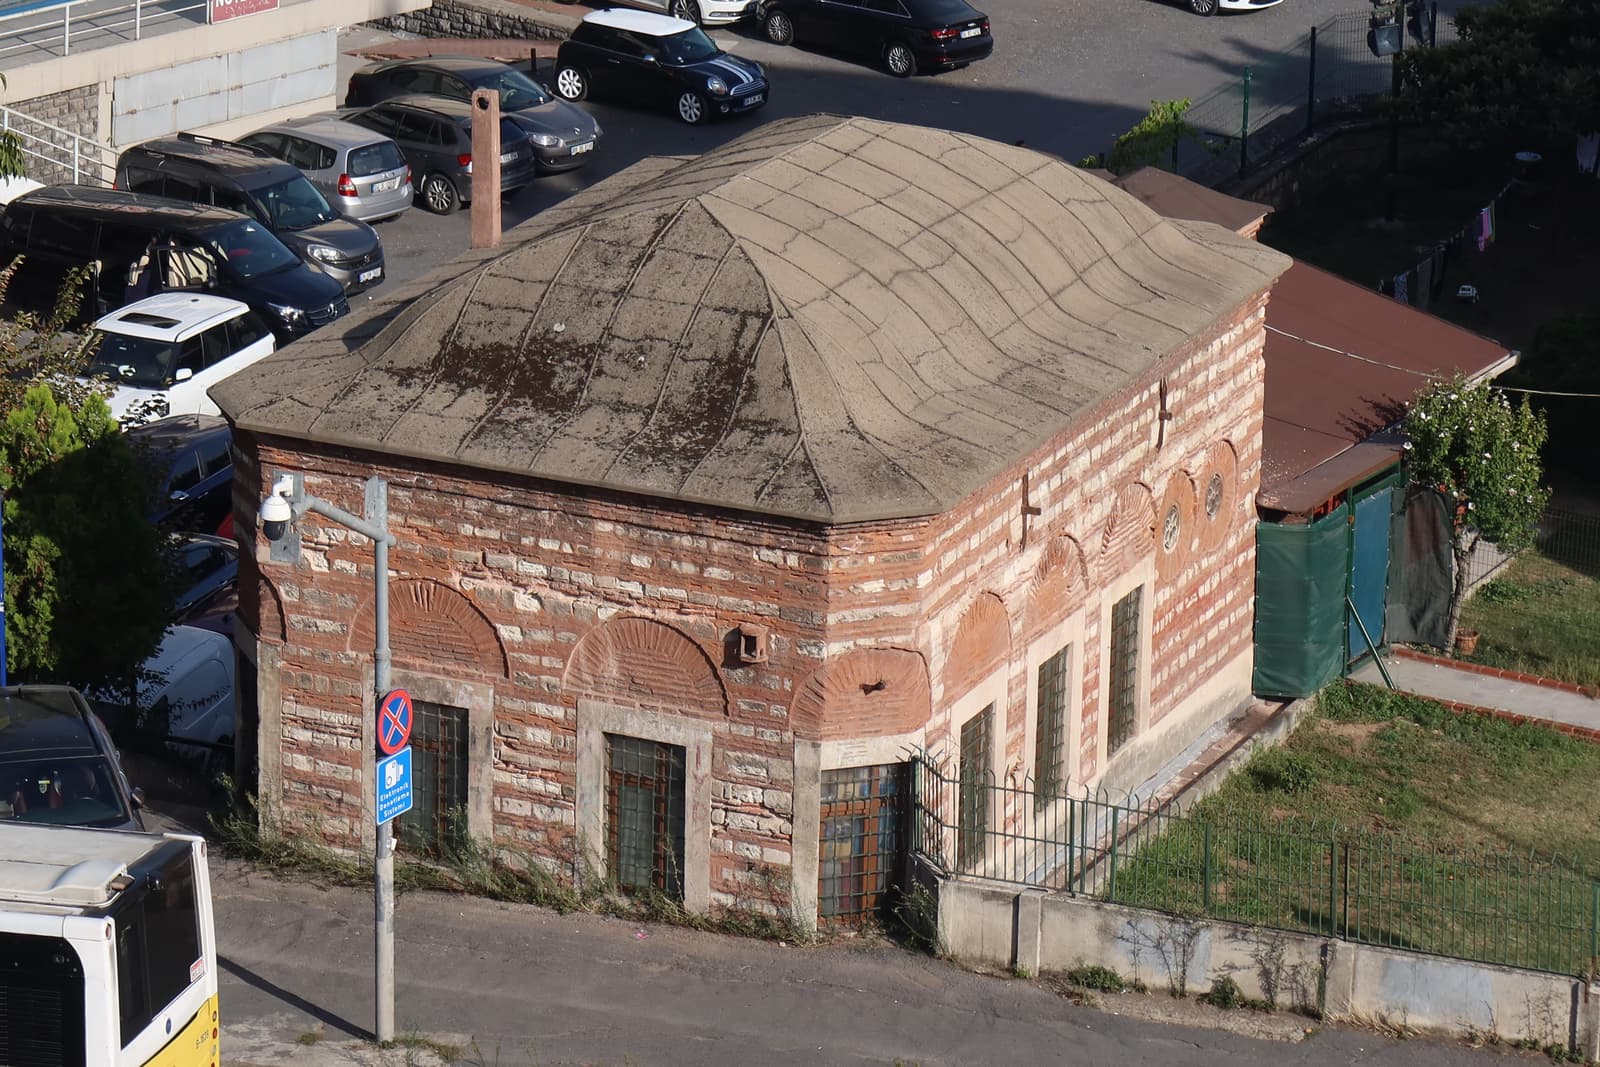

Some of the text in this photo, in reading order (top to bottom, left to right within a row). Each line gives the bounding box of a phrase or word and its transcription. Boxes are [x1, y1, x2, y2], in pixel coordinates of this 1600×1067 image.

[380, 782, 409, 802] Elektronik
[380, 792, 409, 811] Denetleme
[384, 801, 406, 817] Sistemi
